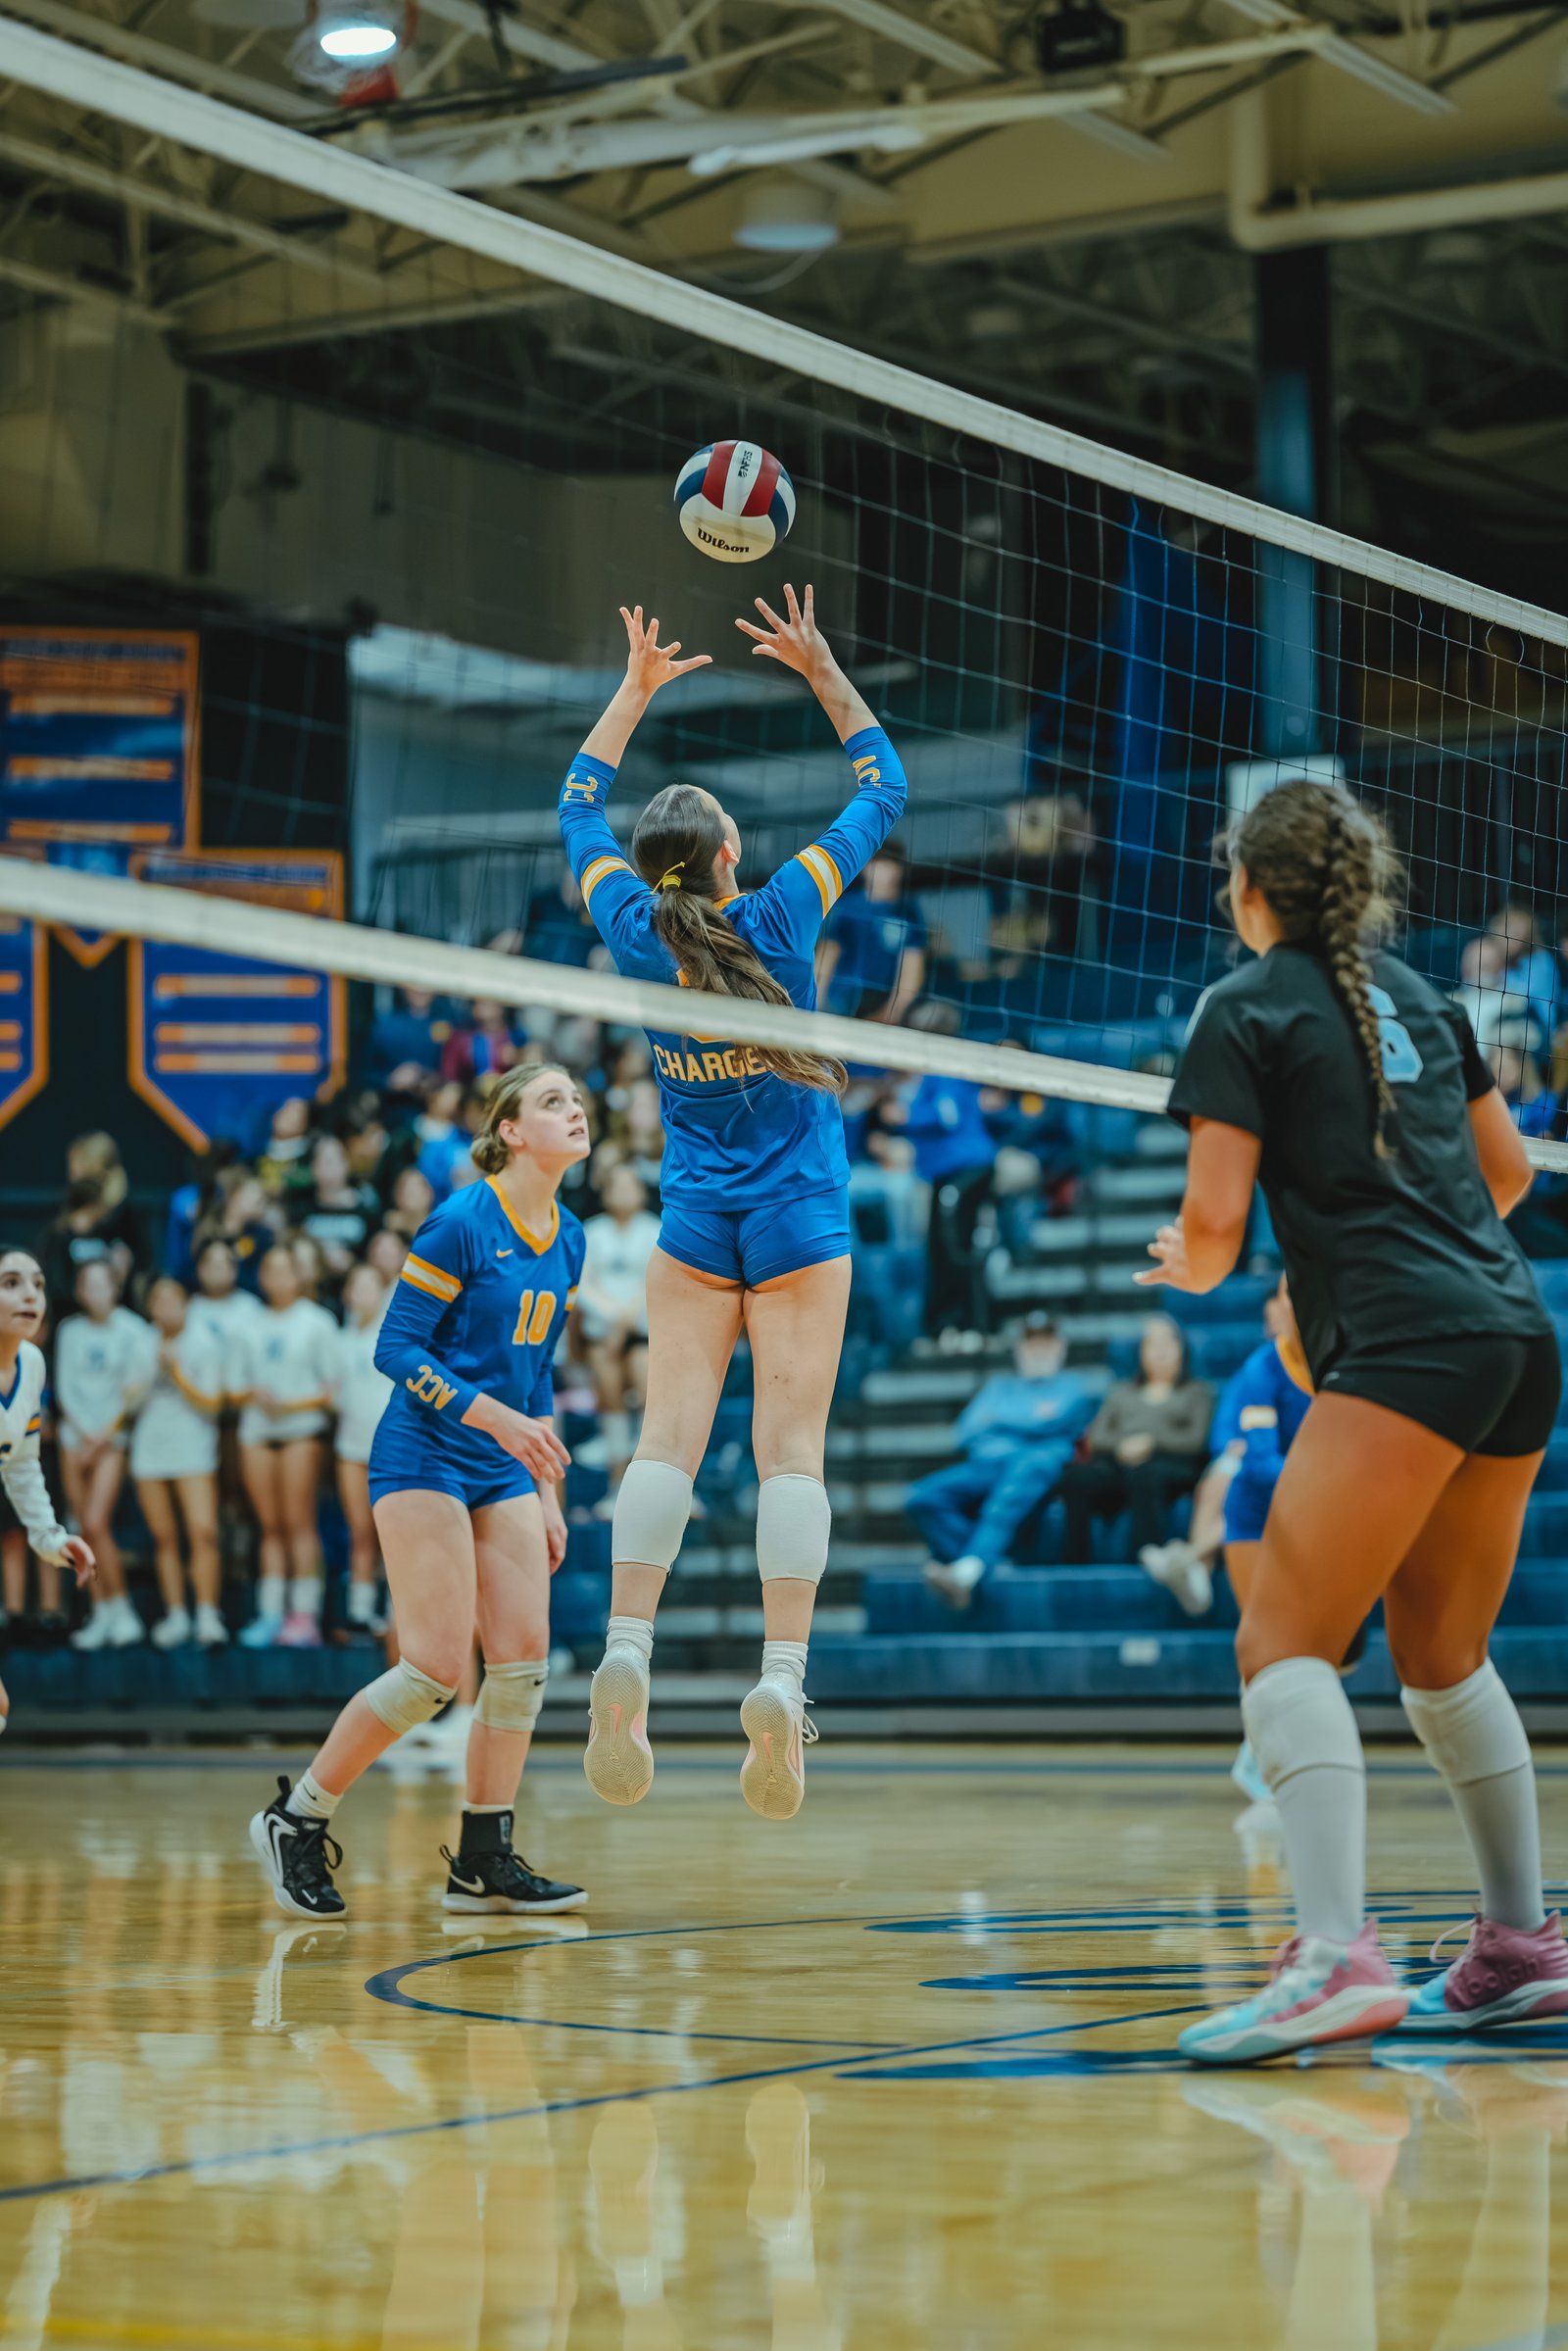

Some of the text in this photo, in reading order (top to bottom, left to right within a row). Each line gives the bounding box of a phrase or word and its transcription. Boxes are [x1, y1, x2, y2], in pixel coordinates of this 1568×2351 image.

[698, 527, 750, 553] Wilson
[653, 1044, 772, 1083] CHARGE
[512, 1289, 557, 1346] 10
[406, 1365, 459, 1410] ACC
